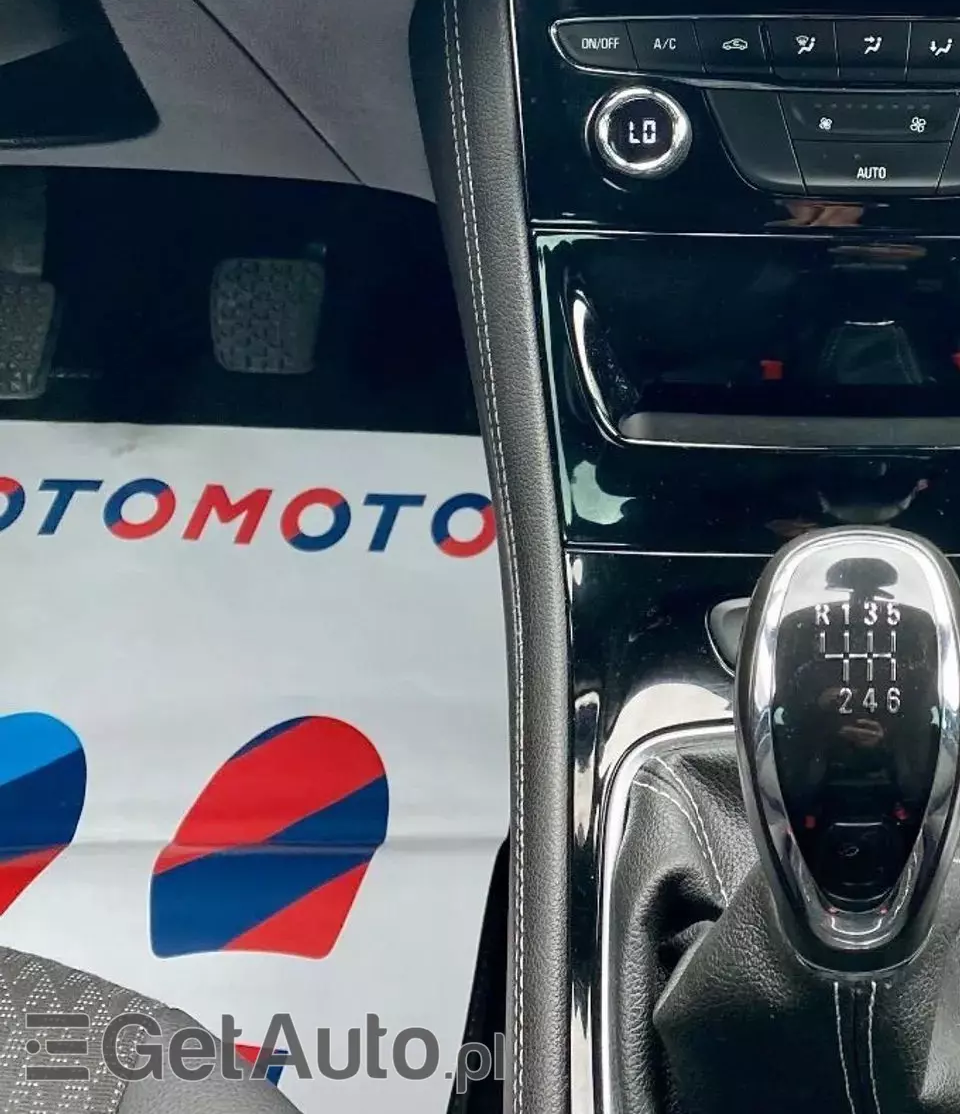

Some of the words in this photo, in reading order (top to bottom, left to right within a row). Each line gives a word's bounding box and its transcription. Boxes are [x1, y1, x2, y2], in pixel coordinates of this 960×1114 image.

[581, 37, 621, 50] ON/OFF
[653, 37, 677, 51] A/C
[856, 165, 887, 180] AUTO
